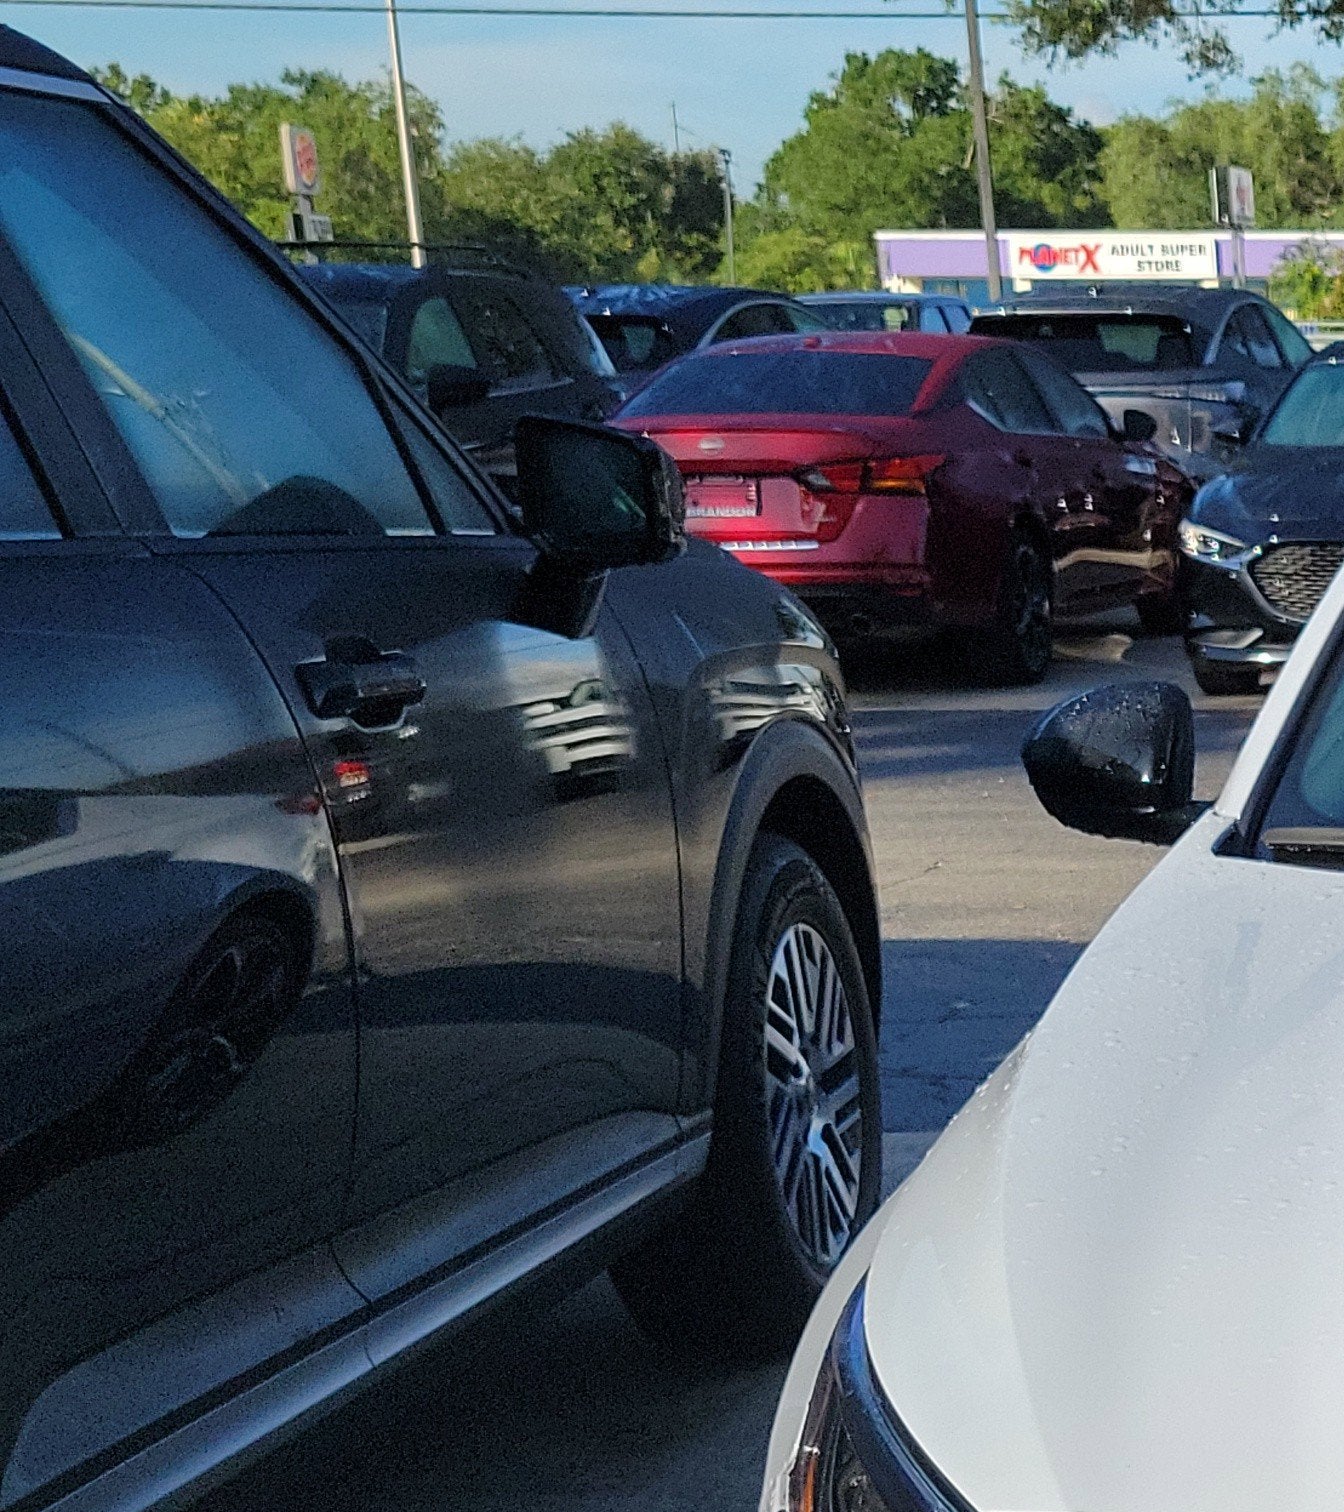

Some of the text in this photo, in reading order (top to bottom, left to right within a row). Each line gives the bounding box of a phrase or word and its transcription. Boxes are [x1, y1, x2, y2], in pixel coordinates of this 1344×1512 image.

[1110, 243, 1207, 257] ADULT SUPER
[1136, 260, 1183, 273] STORE
